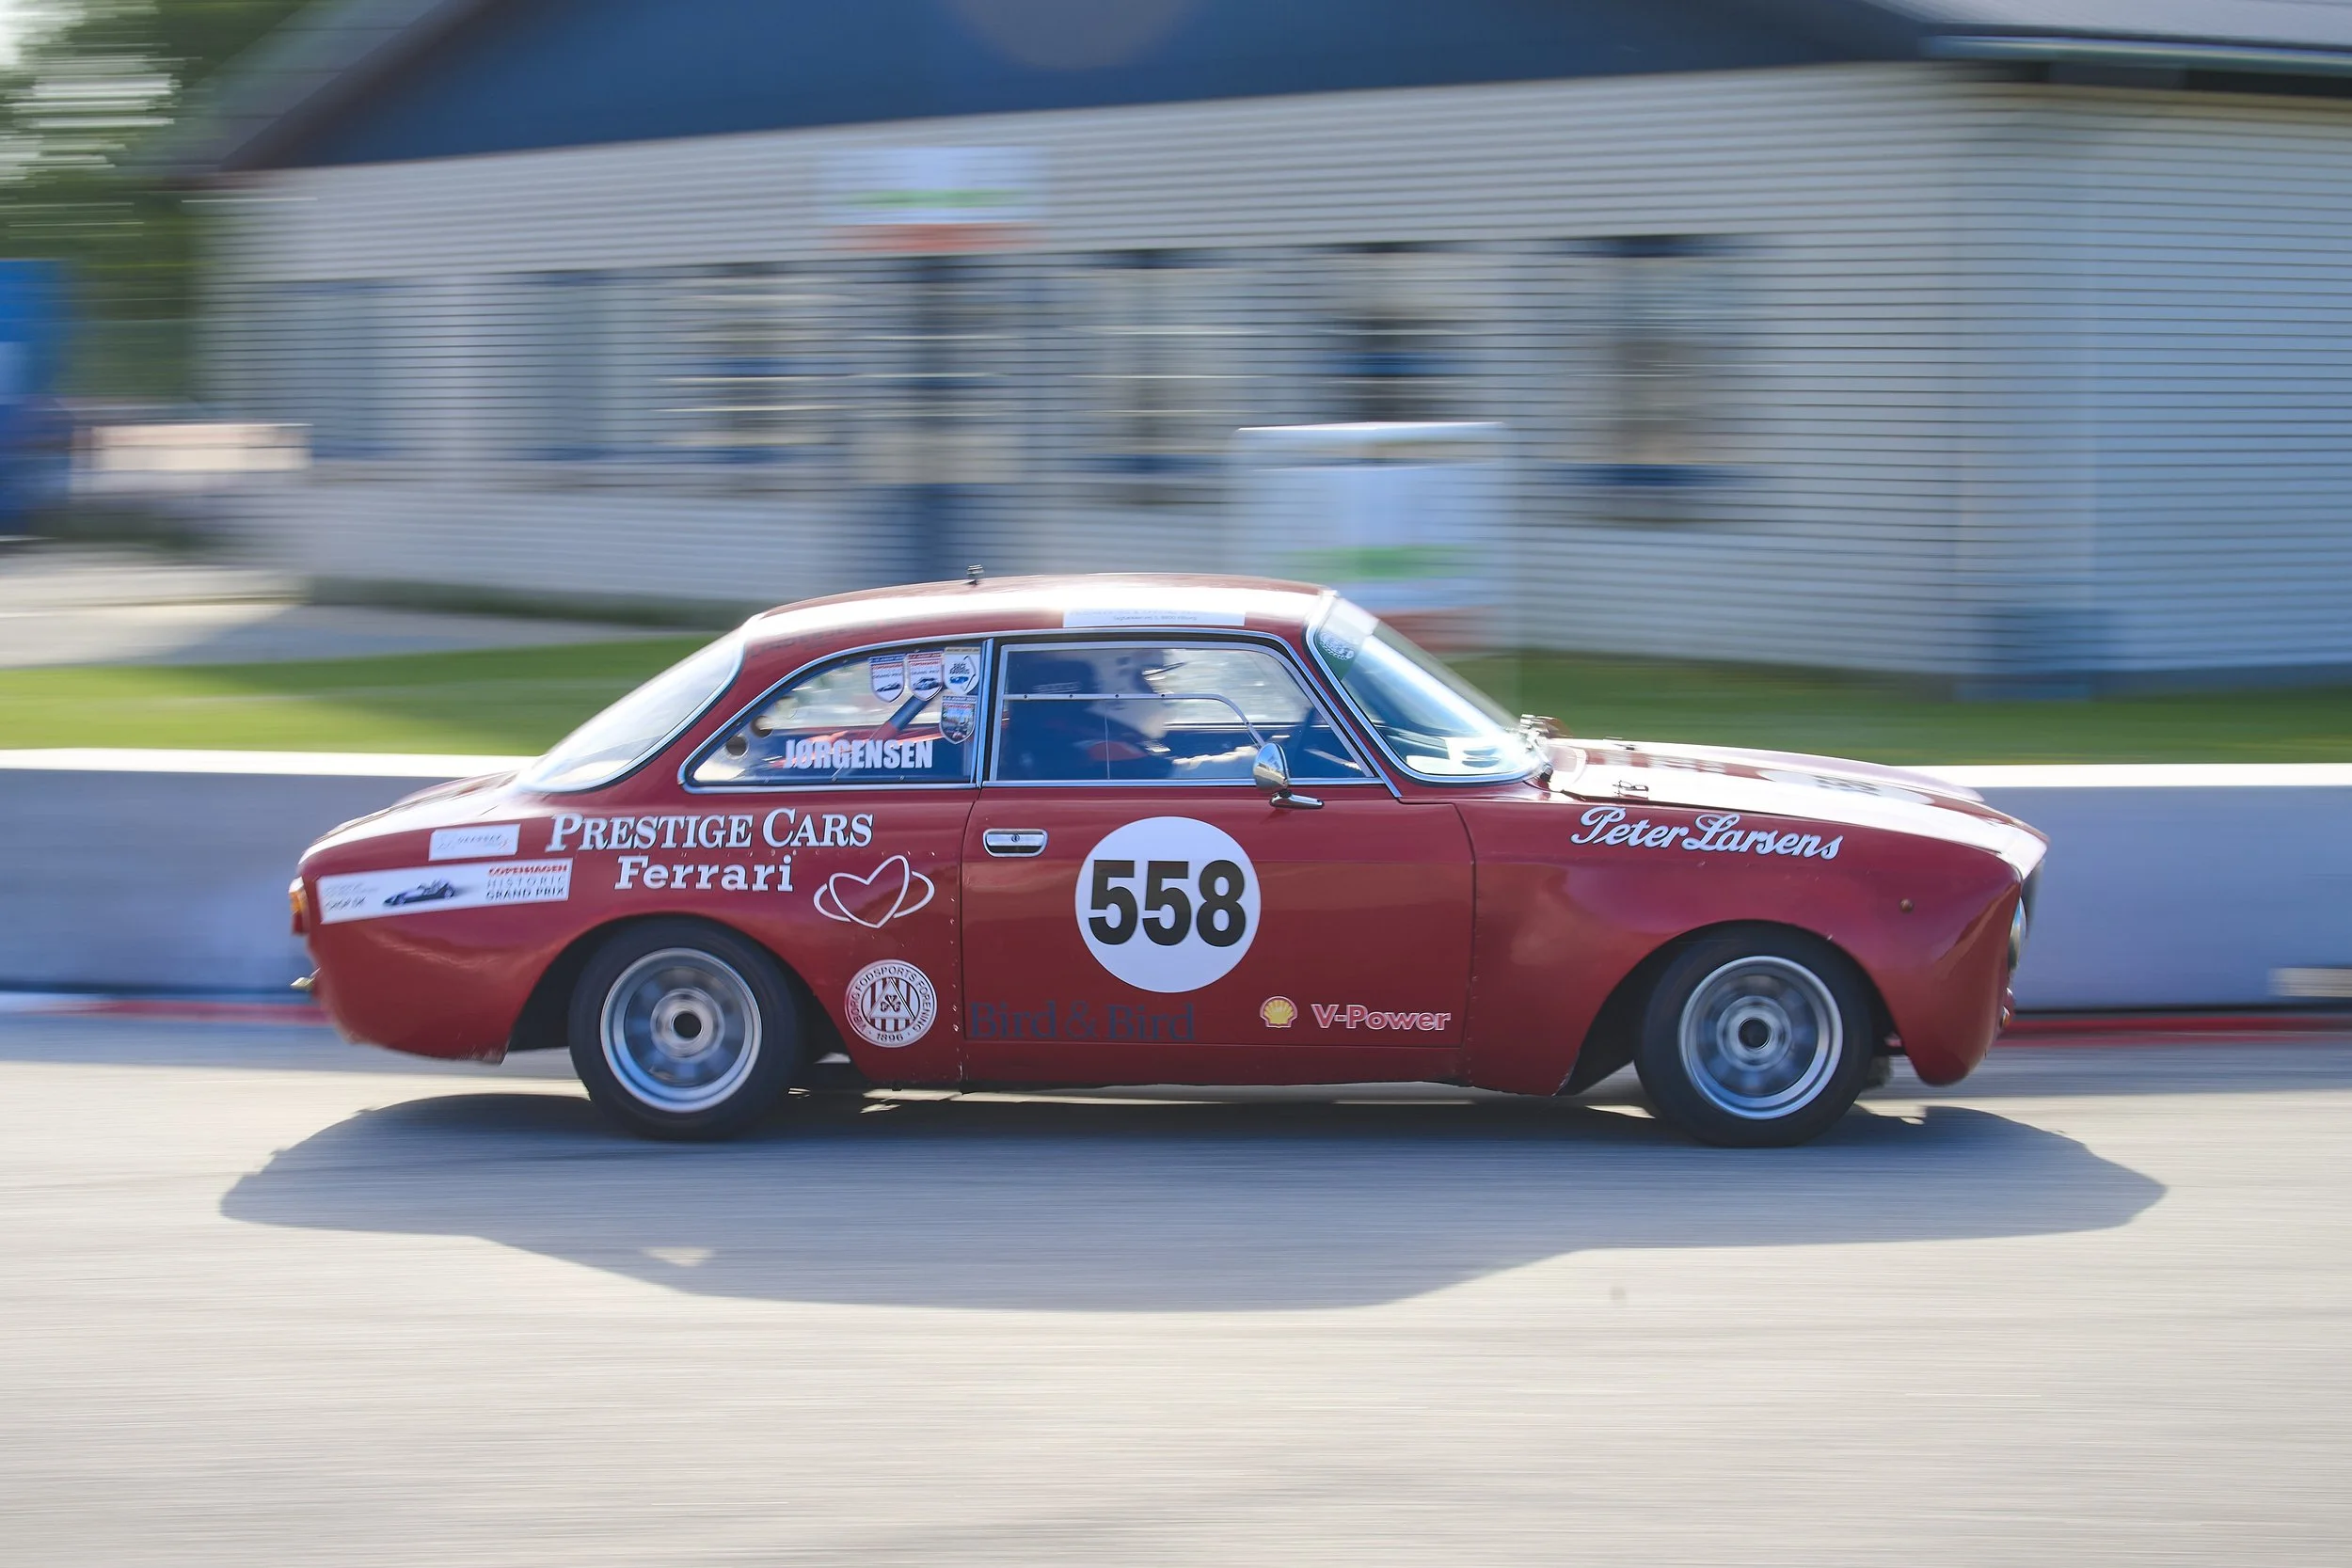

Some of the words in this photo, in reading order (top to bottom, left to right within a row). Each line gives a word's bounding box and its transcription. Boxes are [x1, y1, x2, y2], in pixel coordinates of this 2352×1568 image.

[783, 739, 933, 769] JØRGENSEN
[545, 813, 753, 852] PRESTIGE
[762, 807, 874, 847] CARS
[1570, 805, 1690, 848] Peter
[1681, 813, 1844, 861] Larsens
[614, 854, 794, 892] Ferrari
[485, 889, 532, 900] GRAND
[535, 886, 564, 897] PRIX
[1089, 859, 1247, 947] 558
[913, 980, 931, 1033] FORENING
[970, 1000, 1057, 1038] Bird
[1065, 1000, 1097, 1039] &
[1106, 1002, 1196, 1040] Bird
[1311, 1004, 1452, 1031] V-Power
[876, 1033, 904, 1042] 1896
